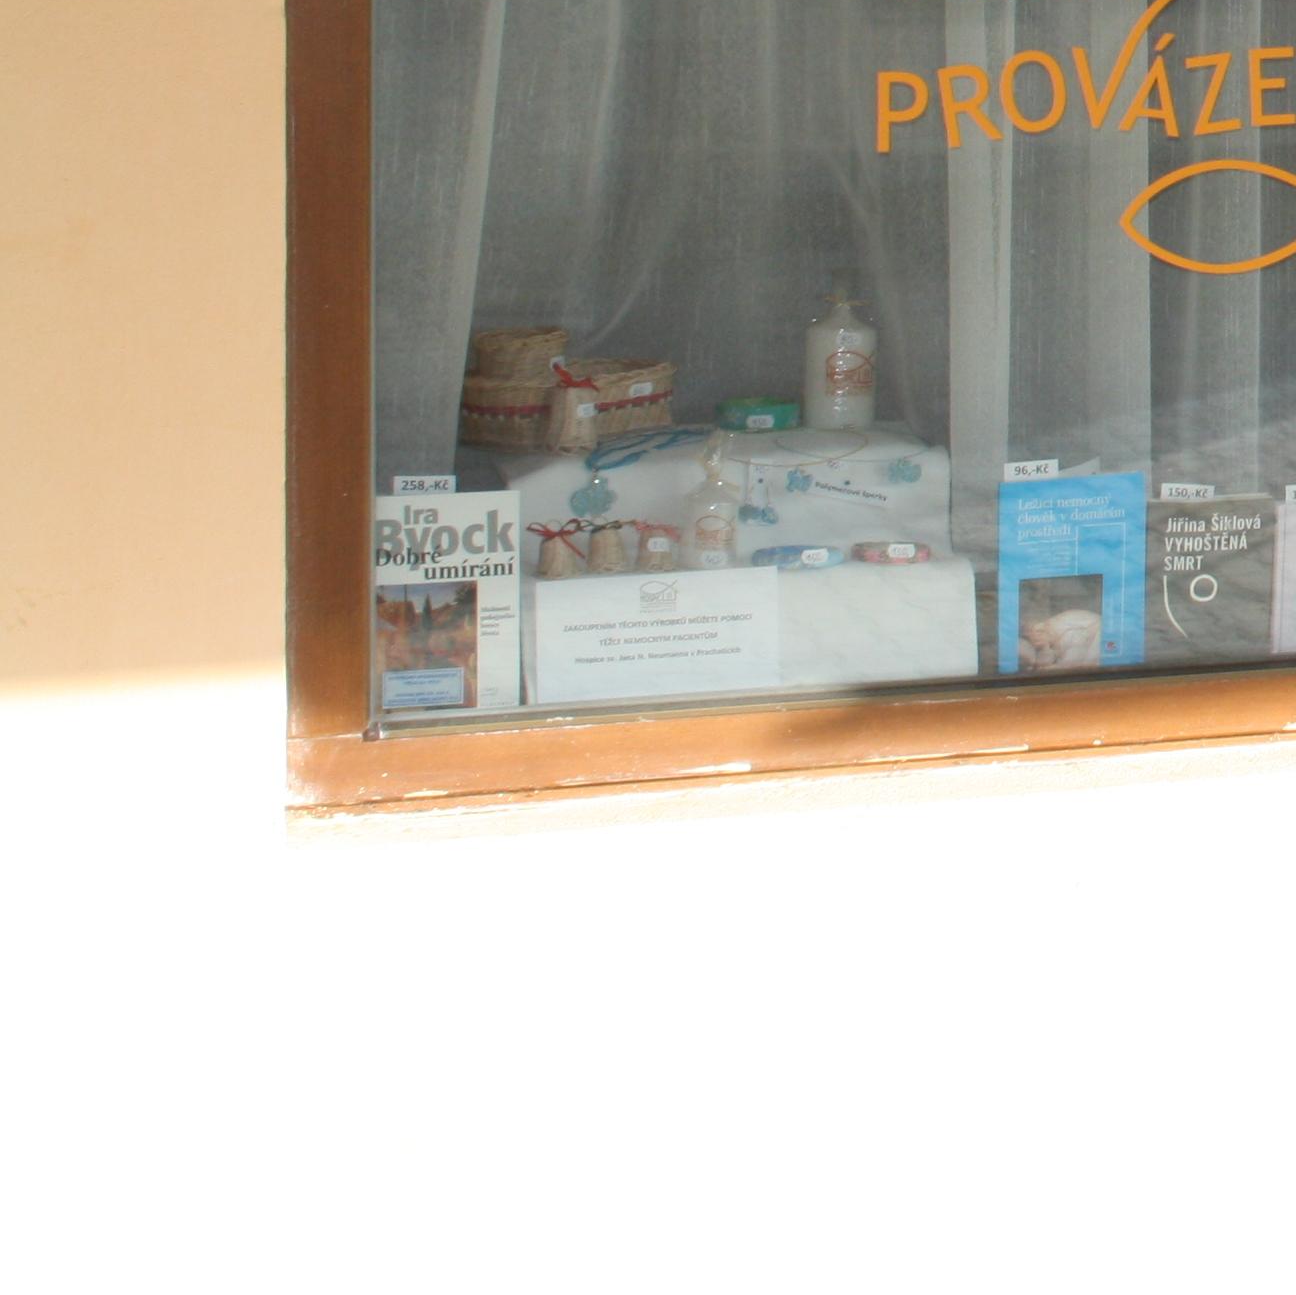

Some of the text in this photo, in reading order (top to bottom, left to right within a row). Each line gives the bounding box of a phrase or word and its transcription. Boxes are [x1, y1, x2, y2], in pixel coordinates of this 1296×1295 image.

[1013, 464, 1050, 476] 96,-Kč
[401, 479, 449, 492] 258,-Kč
[1167, 486, 1208, 498] 150,-Kč
[403, 505, 439, 525] Ira
[1165, 512, 1261, 533] Jiřina Šiklová
[375, 508, 517, 571] Byock
[1164, 531, 1248, 553] VYHOŠTĚNÁ
[375, 545, 442, 567] Dobré
[1163, 555, 1204, 571] SMRT
[424, 556, 516, 581] umírání
